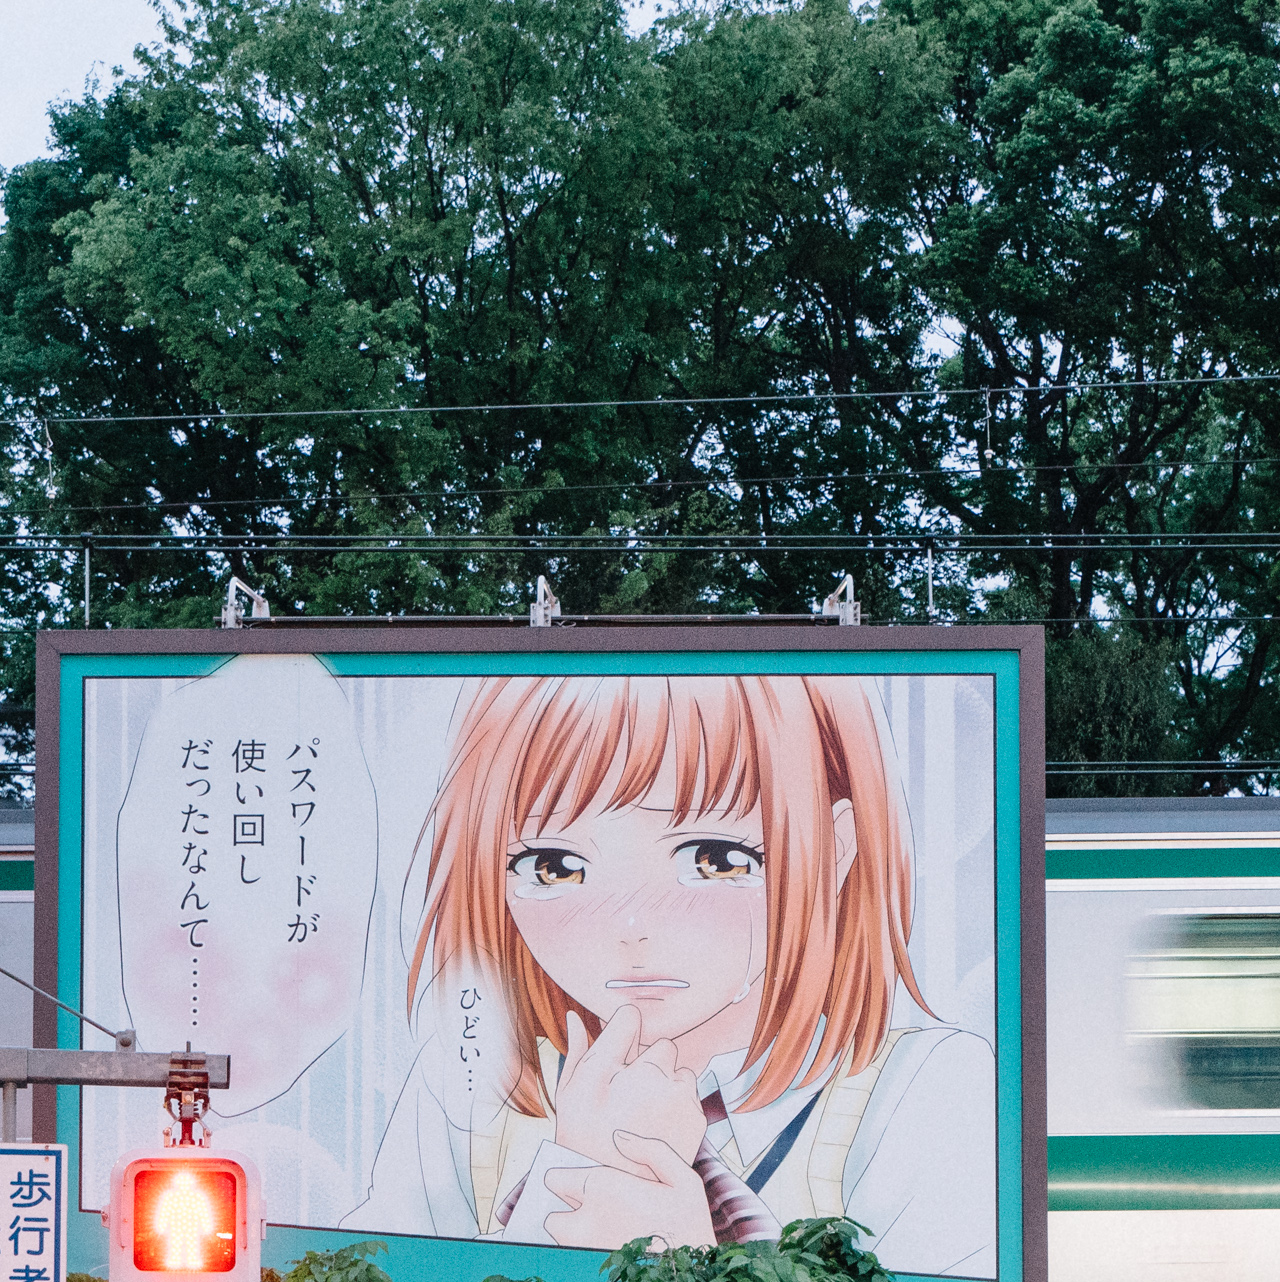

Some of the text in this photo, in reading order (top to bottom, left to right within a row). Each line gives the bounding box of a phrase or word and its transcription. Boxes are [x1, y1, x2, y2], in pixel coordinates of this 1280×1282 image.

[231, 739, 267, 885] 使い回し
[286, 737, 321, 943] パスワードが
